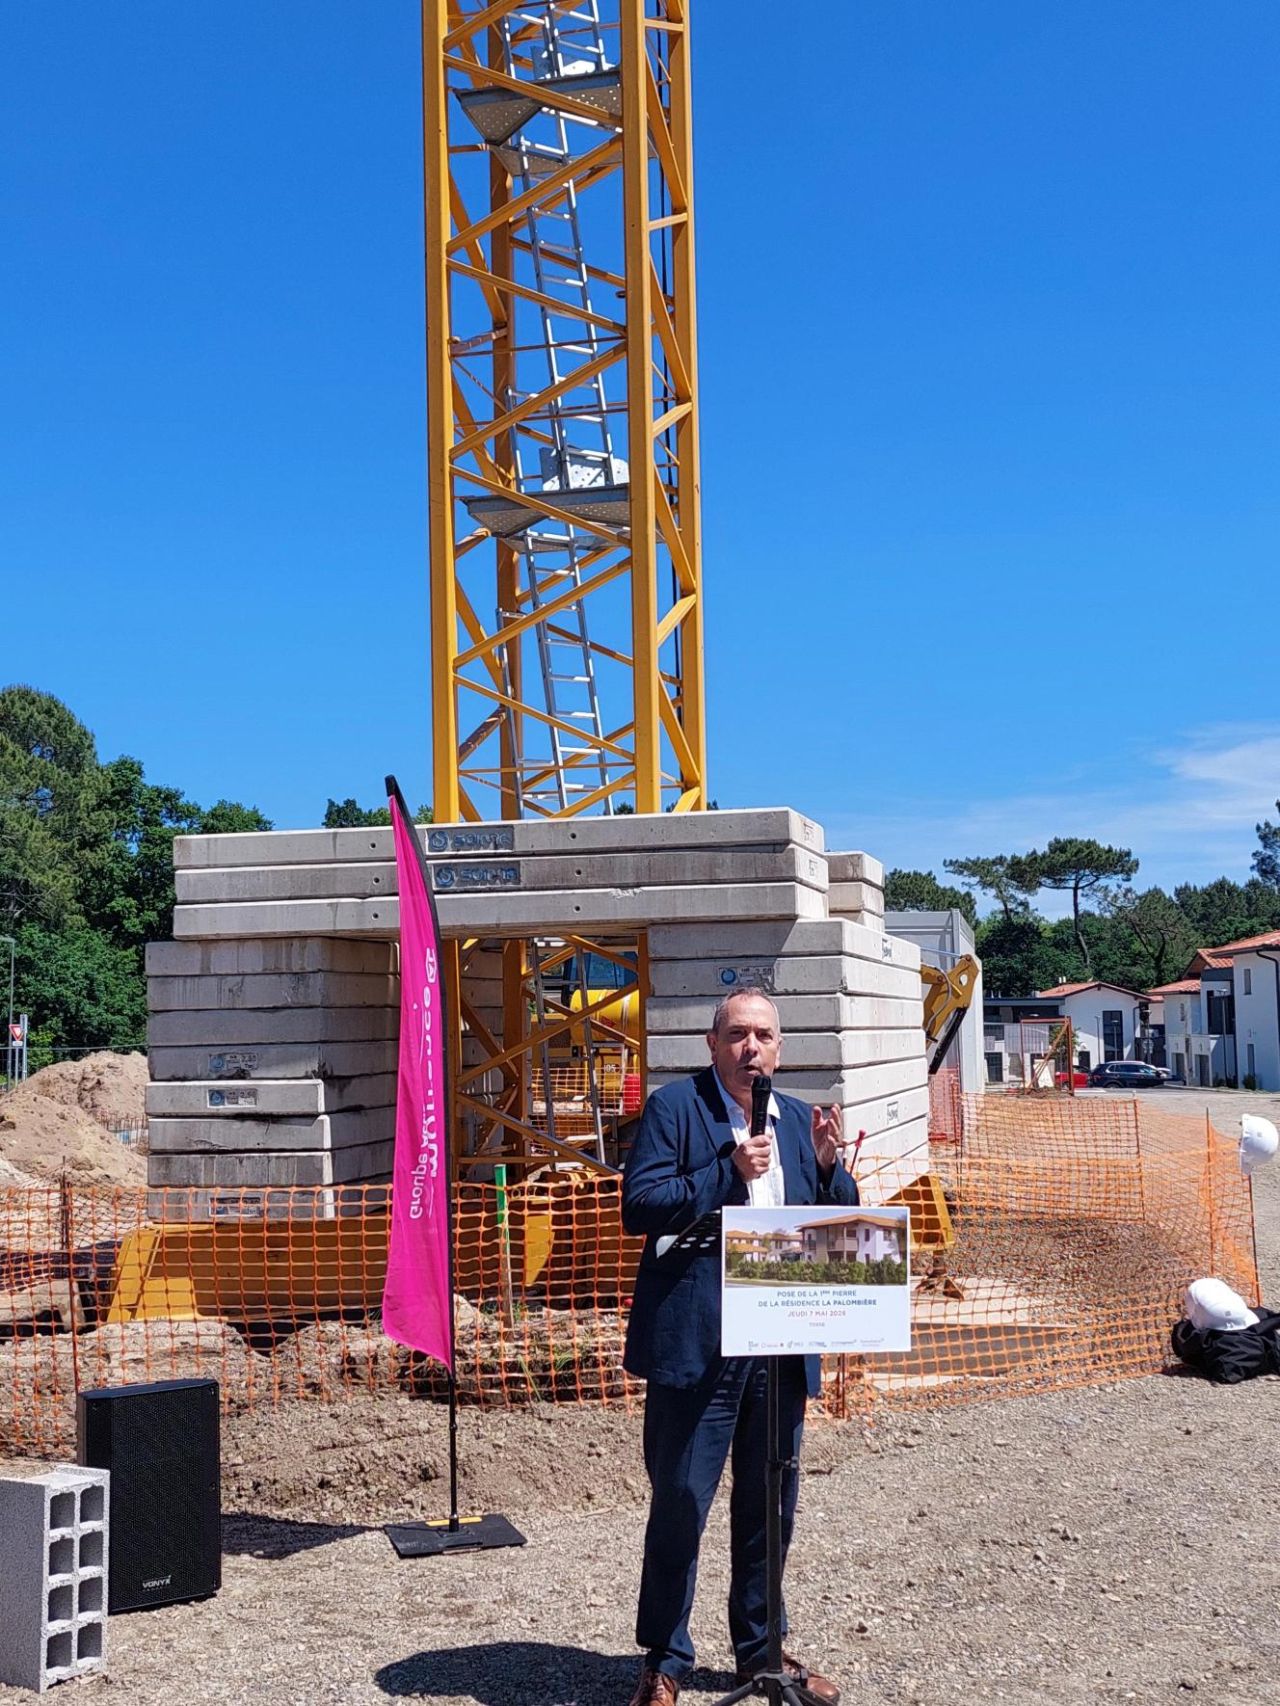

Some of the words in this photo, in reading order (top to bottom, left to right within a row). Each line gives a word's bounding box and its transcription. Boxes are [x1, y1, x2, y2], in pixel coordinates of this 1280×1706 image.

[781, 1298, 820, 1307] RÉSIDENCE
[833, 1298, 877, 1306] PALOMBIÈRE
[142, 1575, 172, 1588] VONYX
